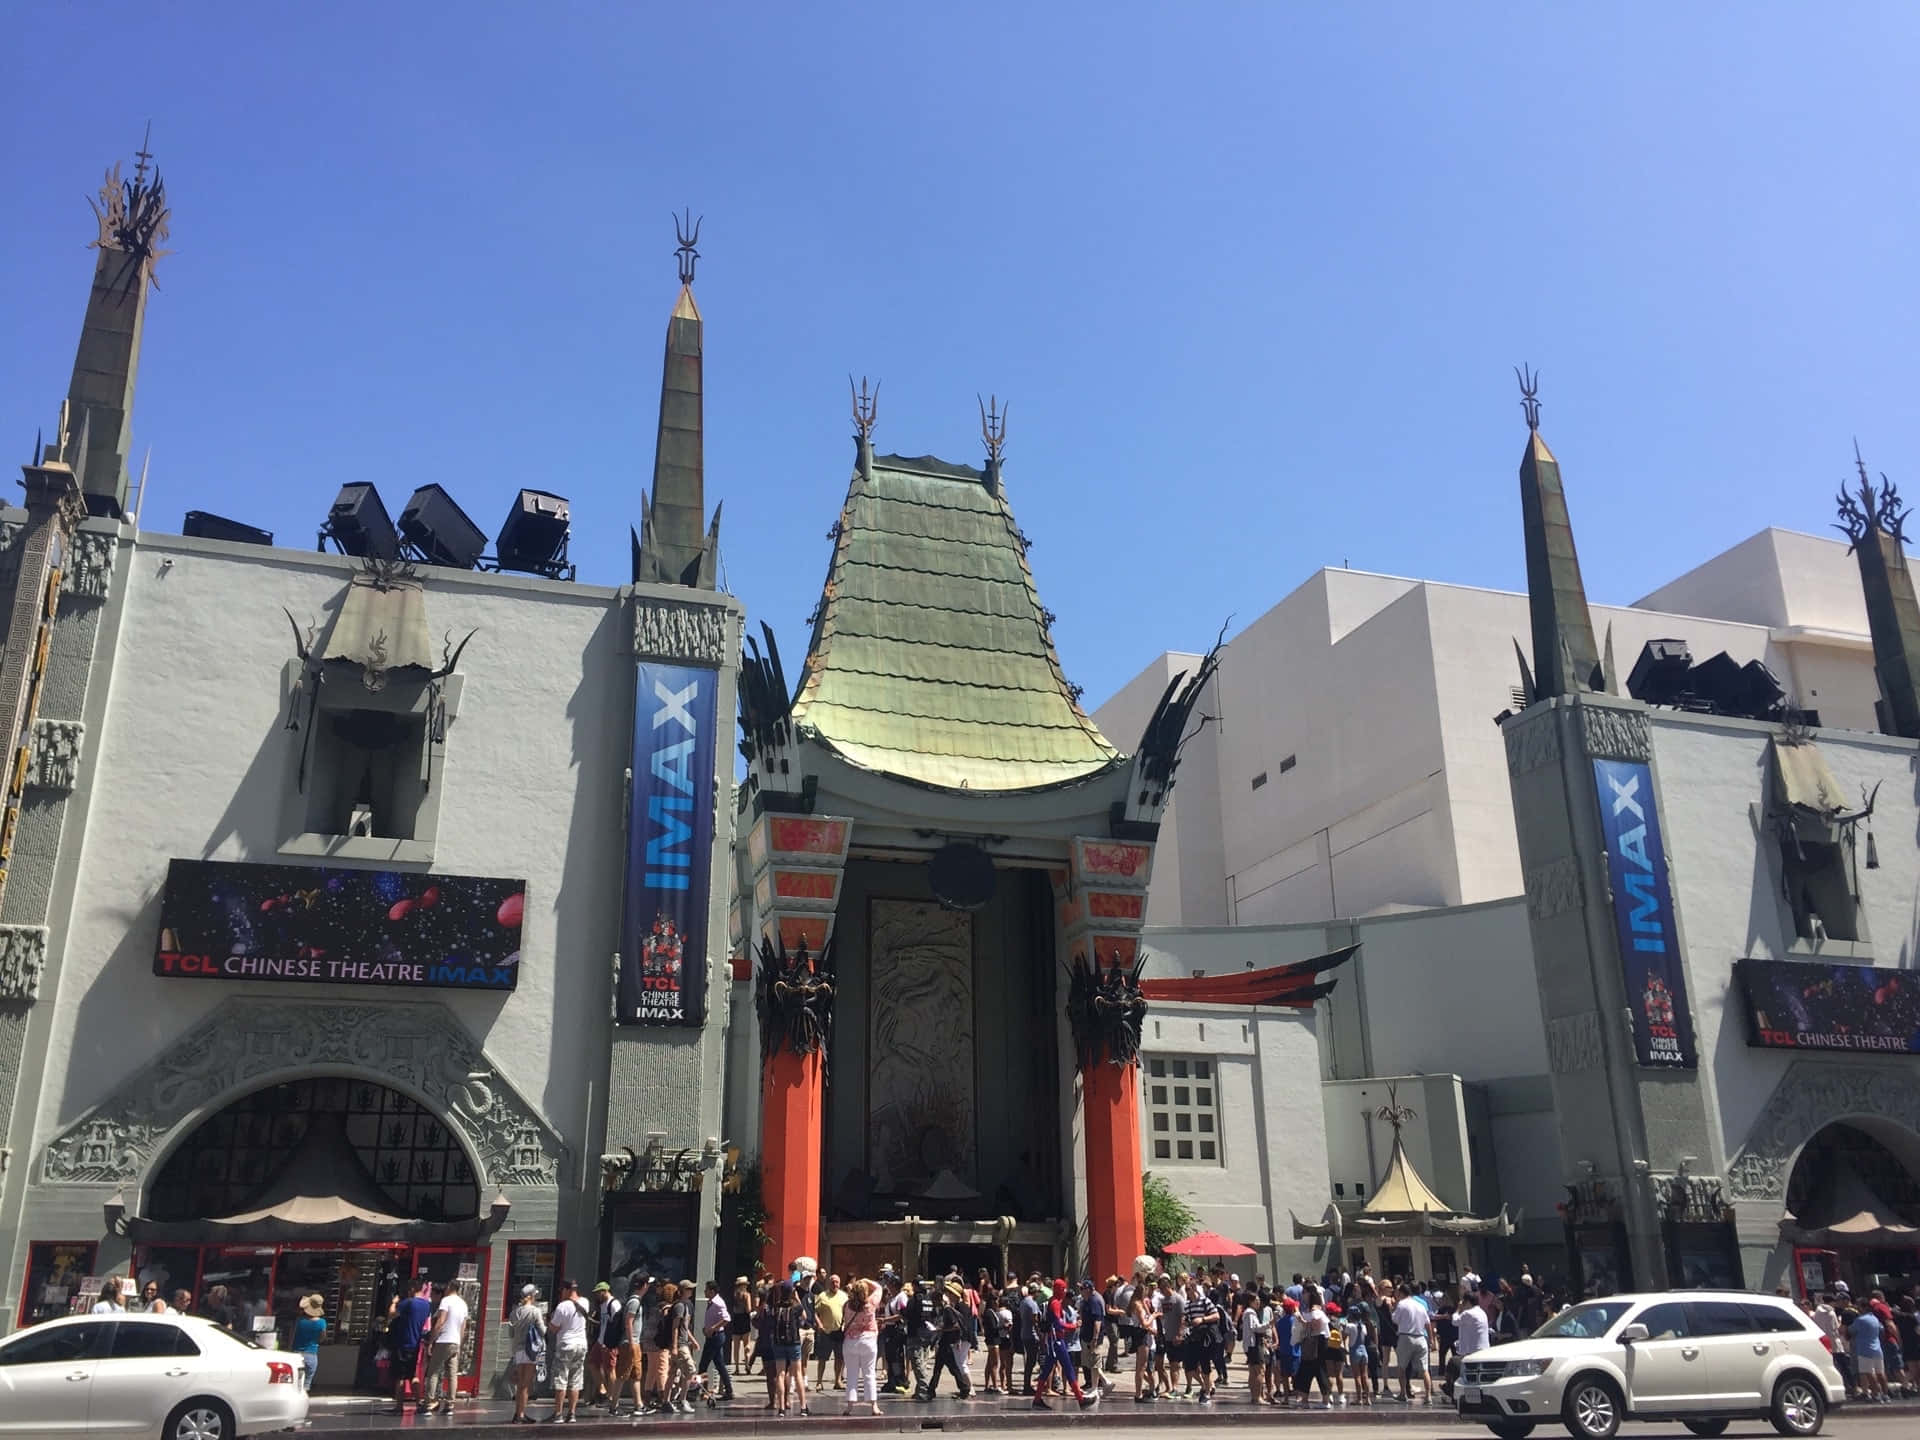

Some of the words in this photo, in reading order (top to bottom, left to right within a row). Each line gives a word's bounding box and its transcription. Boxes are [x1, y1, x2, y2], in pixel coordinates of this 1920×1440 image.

[643, 678, 699, 891] IMAX
[1607, 773, 1666, 953] IMAX
[159, 954, 218, 973] TCL
[224, 956, 322, 978] CHINESE
[327, 960, 424, 982] THEATRE
[429, 966, 512, 984] IMAX
[642, 976, 681, 991] TCL
[641, 990, 680, 1000] CHINESE
[636, 1007, 685, 1020] IMAX
[1649, 1025, 1677, 1037] TCL
[1761, 1029, 1796, 1045] TCL
[1797, 1032, 1851, 1047] CHINESE
[1854, 1034, 1909, 1050] THEATRE
[1650, 1050, 1684, 1062] IMAX
